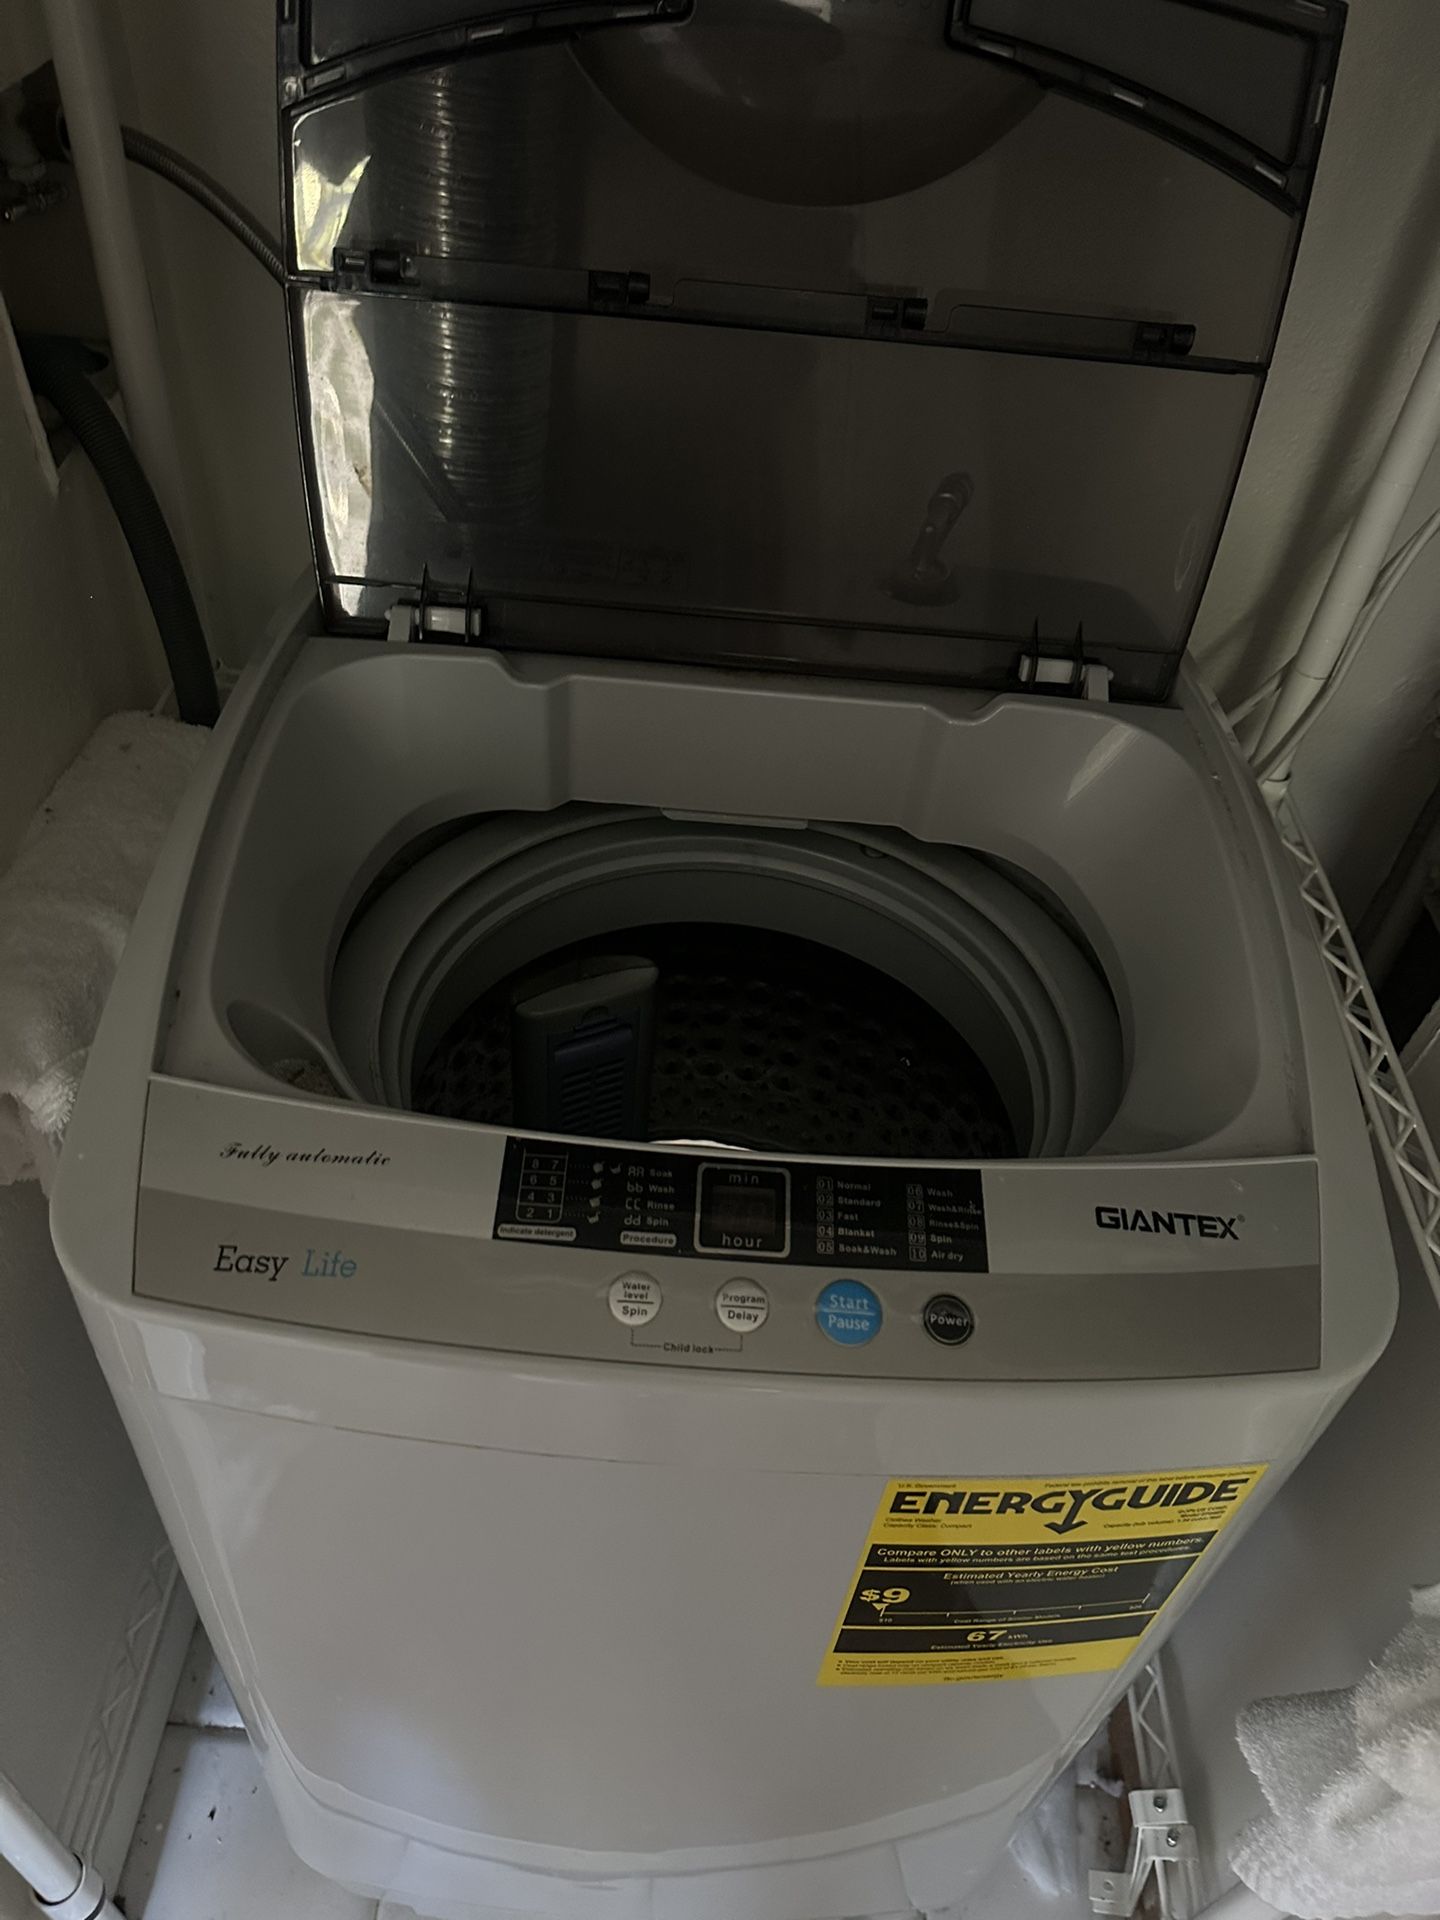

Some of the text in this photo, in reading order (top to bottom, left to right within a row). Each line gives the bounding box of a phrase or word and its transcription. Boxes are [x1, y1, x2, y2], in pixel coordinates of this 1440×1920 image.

[219, 1141, 391, 1167] Fully automatic
[532, 1160, 559, 1170] 8 7
[649, 1166, 673, 1178] Soak
[530, 1176, 557, 1186] 6 5
[729, 1172, 759, 1185] min
[648, 1183, 675, 1194] Wash
[818, 1179, 872, 1192] 01 Normal
[528, 1192, 555, 1203] 4 3
[926, 1187, 953, 1198] Wash
[646, 1199, 675, 1210] Rinse
[818, 1194, 881, 1208] 02 Standard
[526, 1208, 553, 1219] 2 1
[908, 1201, 982, 1215] 07 Wash&Rinse
[624, 1215, 669, 1228] dd Spin
[818, 1210, 859, 1222] 03 Fast
[929, 1219, 979, 1231] Rinse&Spin
[1095, 1206, 1240, 1241] GIANTEX
[534, 1228, 574, 1238] detergent
[818, 1226, 875, 1238] 04 Blanket
[623, 1234, 674, 1246] Procedure
[721, 1233, 763, 1248] hour
[910, 1233, 953, 1245] 09 Spin
[818, 1242, 897, 1256] 05 Soak&Wash
[911, 1248, 964, 1262] 10 Air dry
[213, 1244, 358, 1283] Easy Life
[622, 1281, 650, 1291] Water
[624, 1290, 649, 1300] level
[722, 1293, 766, 1305] Program
[830, 1294, 869, 1310] Start
[622, 1305, 648, 1317] Spin
[727, 1310, 759, 1323] Delay
[828, 1314, 870, 1331] Pause
[930, 1314, 969, 1327] Power
[663, 1342, 714, 1354] Child lock
[889, 1478, 1250, 1534] ENERGYGUIDE
[877, 1547, 937, 1558] Compare
[940, 1548, 979, 1557] ONLY
[980, 1548, 993, 1556] to
[996, 1547, 1030, 1556] other
[1034, 1546, 1071, 1555] labels
[1076, 1545, 1102, 1553] with
[1104, 1542, 1146, 1552] yellow
[943, 1566, 1119, 1581] Estimated Yearly Energy Cost
[859, 1587, 910, 1604] $9
[966, 1630, 1008, 1642] 67
